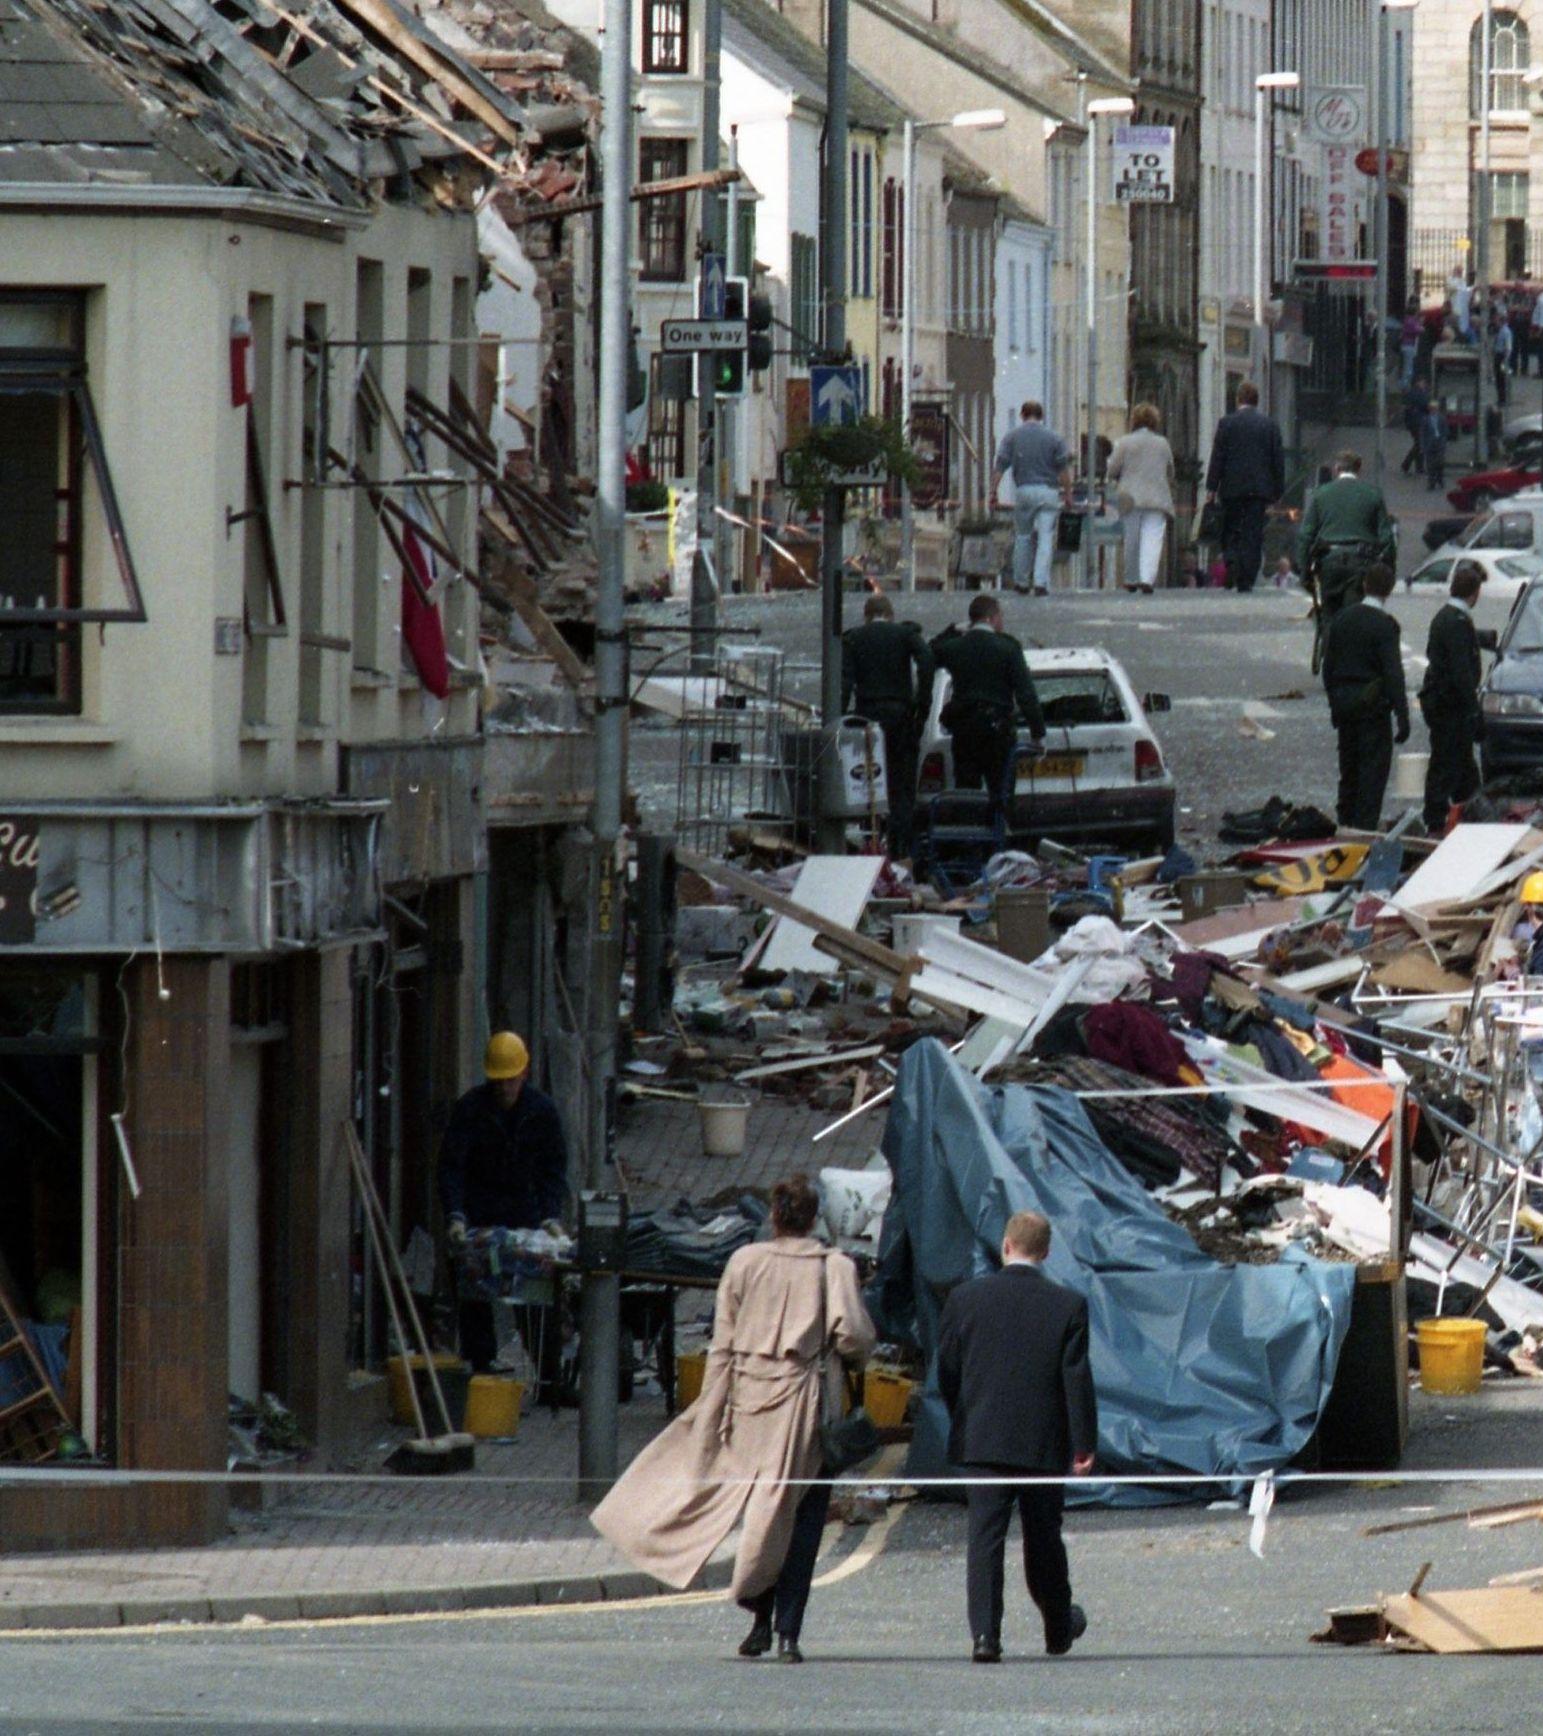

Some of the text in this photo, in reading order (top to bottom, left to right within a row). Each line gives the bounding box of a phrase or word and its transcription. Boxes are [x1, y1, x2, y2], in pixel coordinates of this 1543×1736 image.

[1129, 153, 1160, 168] TO
[1122, 168, 1165, 184] LET
[669, 327, 743, 344] One way
